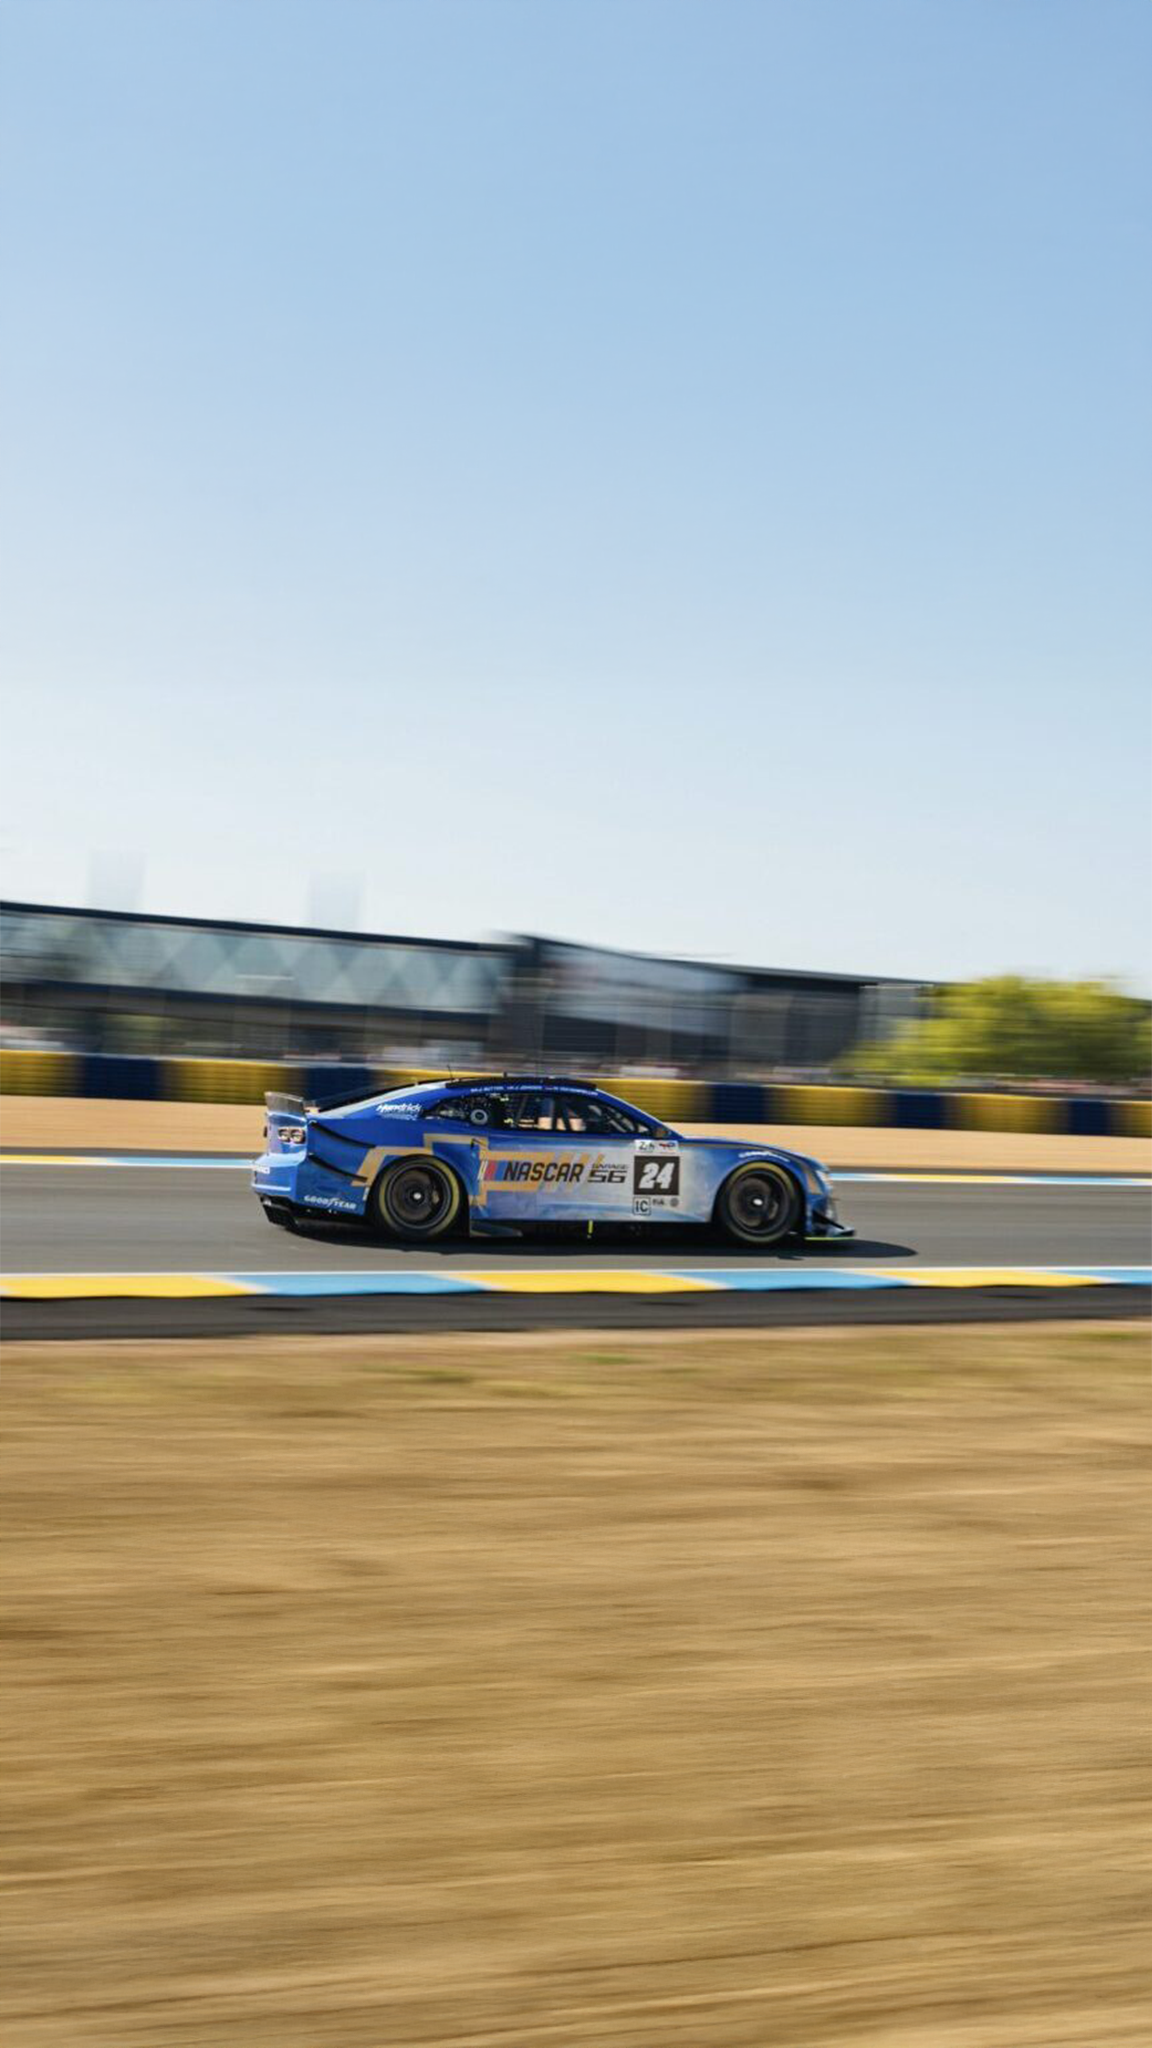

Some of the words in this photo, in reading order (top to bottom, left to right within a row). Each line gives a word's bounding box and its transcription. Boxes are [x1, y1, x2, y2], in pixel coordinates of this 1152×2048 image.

[376, 1103, 422, 1113] Hendrick
[503, 1161, 584, 1183] NASCAR
[587, 1169, 628, 1184] 56
[639, 1162, 675, 1190] 24
[304, 1195, 357, 1210] GOODYEAR
[635, 1200, 649, 1213] IC
